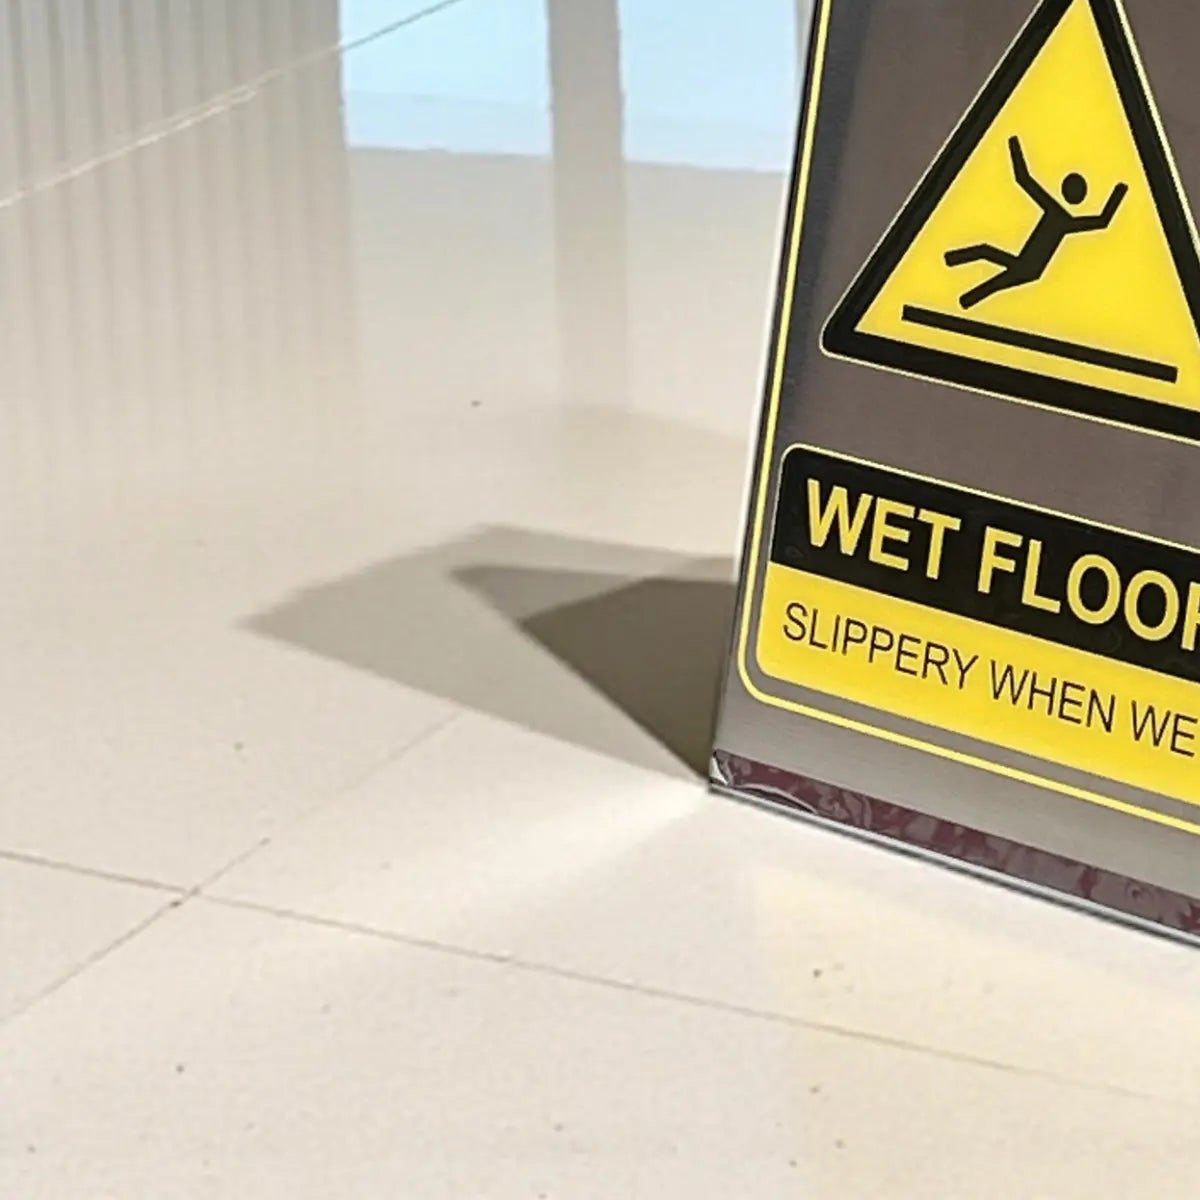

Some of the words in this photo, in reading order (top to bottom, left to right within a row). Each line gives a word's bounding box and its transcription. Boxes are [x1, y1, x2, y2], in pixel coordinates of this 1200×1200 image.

[806, 477, 962, 580] WET
[782, 602, 979, 691] SLIPPERY
[990, 659, 1117, 734] WHEN
